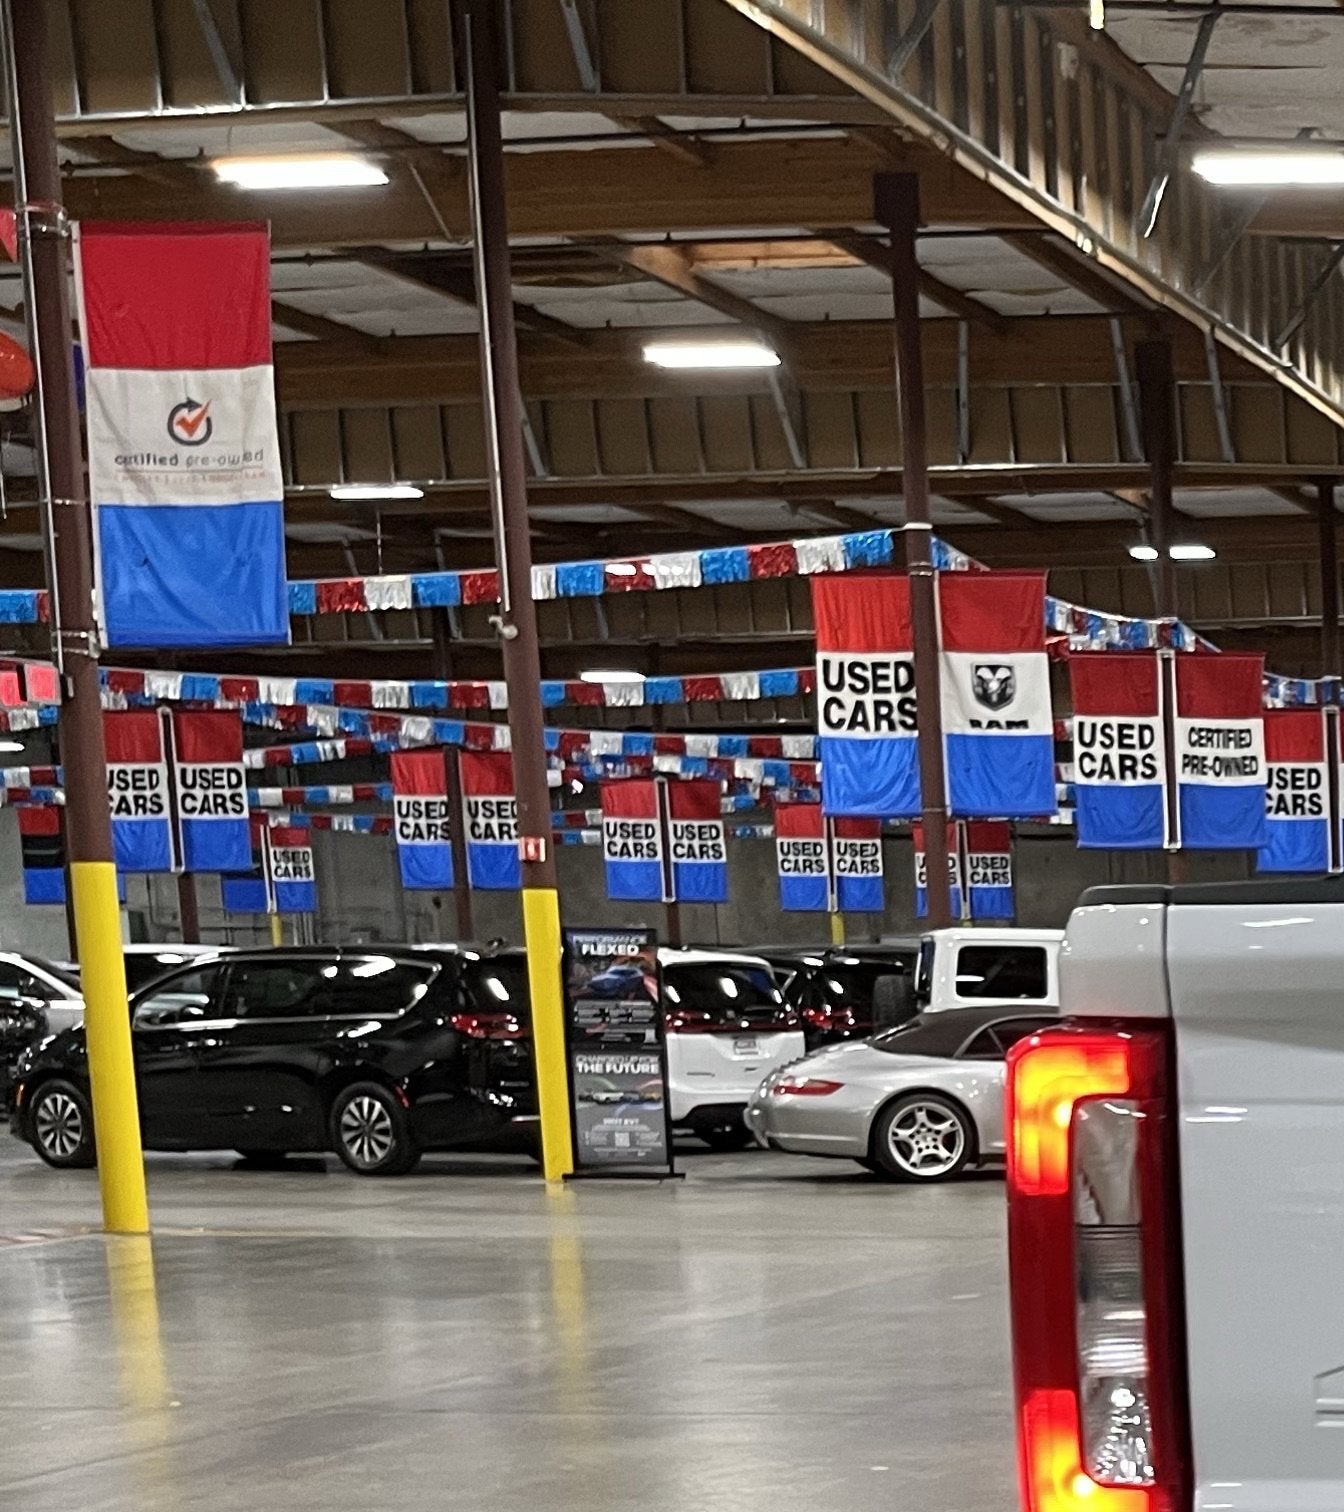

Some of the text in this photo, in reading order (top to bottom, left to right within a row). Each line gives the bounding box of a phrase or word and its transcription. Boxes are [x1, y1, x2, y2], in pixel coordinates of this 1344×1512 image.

[823, 659, 915, 695] USED
[824, 696, 918, 732] CARS
[969, 719, 1028, 729] RAM
[1078, 722, 1154, 750] USED
[1188, 727, 1252, 749] CERTIFIED
[1079, 751, 1157, 780] CARS
[1182, 754, 1258, 777] PRE-OWNED
[180, 768, 243, 791] USED
[181, 792, 245, 815] CARS
[397, 800, 447, 820] USED
[399, 821, 450, 841] CARS
[606, 821, 655, 840] USED
[673, 823, 720, 841] USED
[273, 850, 311, 864] USED
[607, 840, 658, 859] CARS
[673, 842, 723, 860] CARS
[780, 841, 823, 857] USED
[836, 842, 879, 857] USED
[273, 865, 312, 879] CARS
[780, 858, 825, 874] CARS
[836, 858, 880, 874] CARS
[970, 856, 1009, 870] USED
[970, 871, 1010, 885] CARS
[577, 1062, 659, 1074] THE FUTURE
